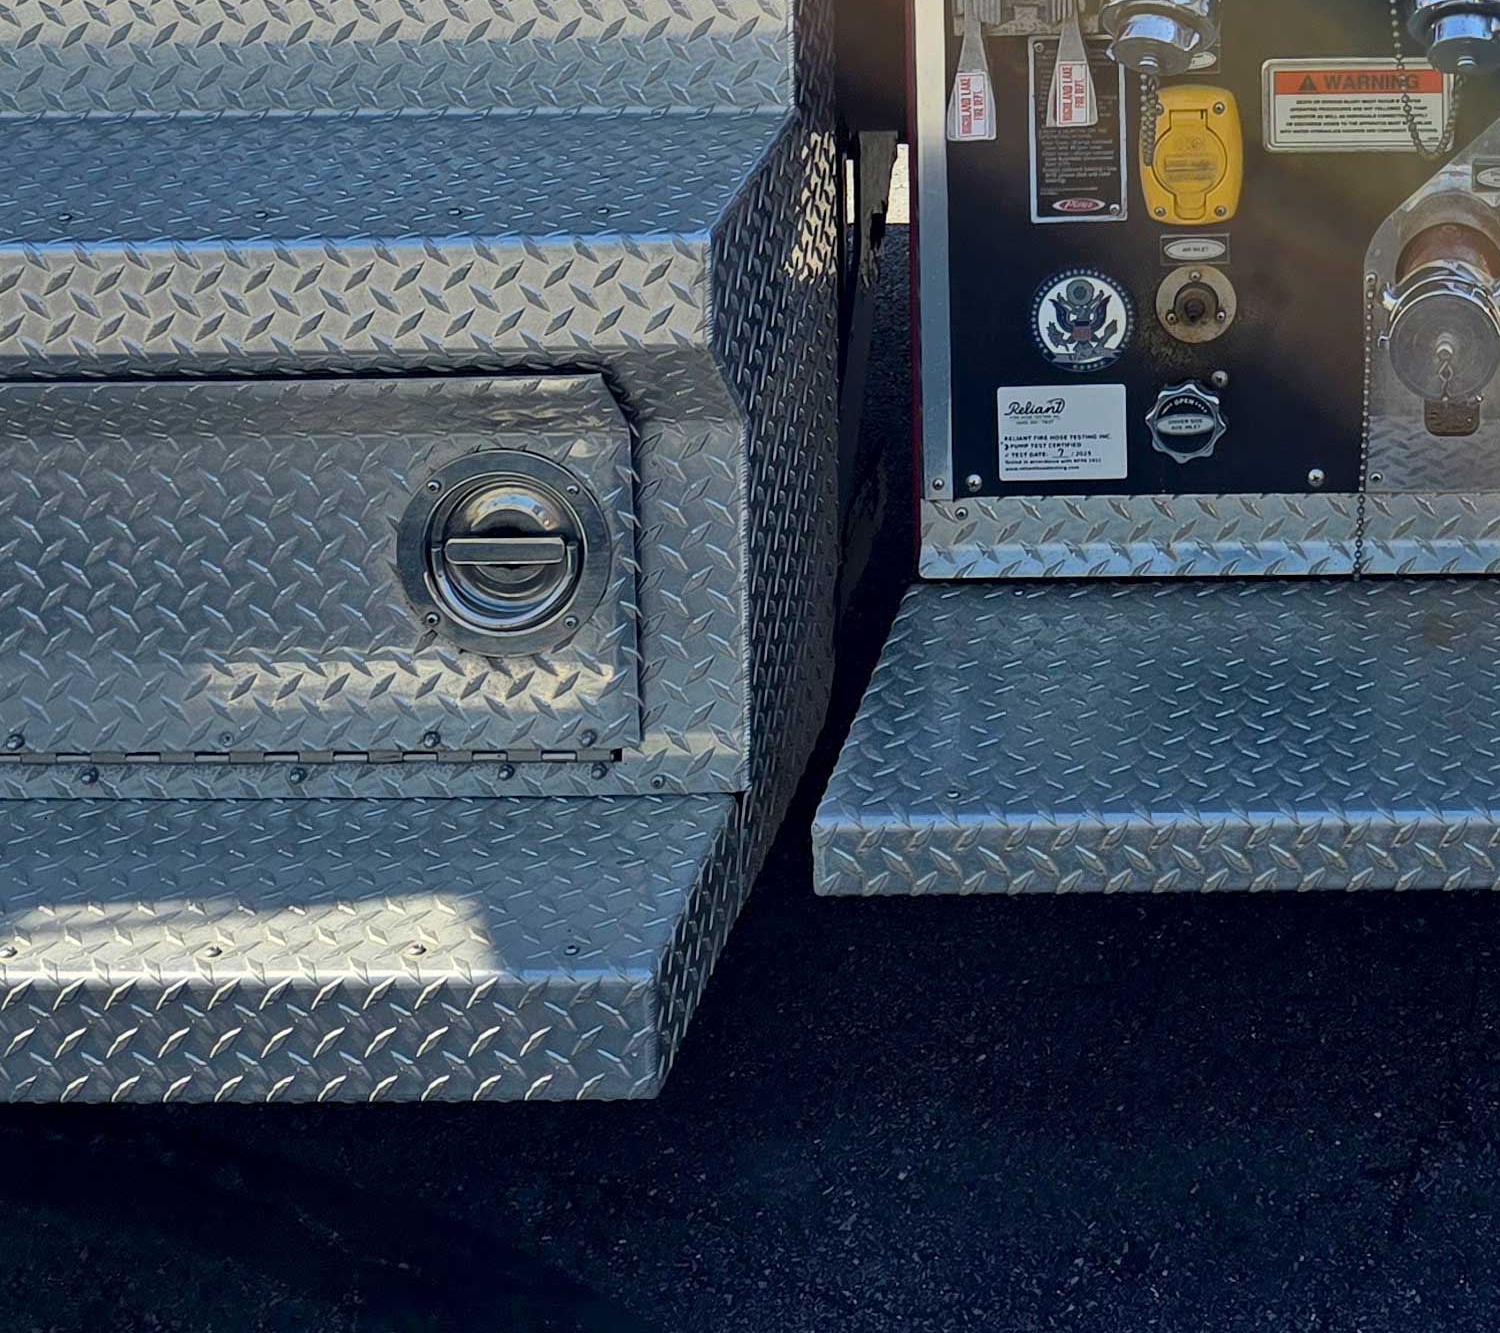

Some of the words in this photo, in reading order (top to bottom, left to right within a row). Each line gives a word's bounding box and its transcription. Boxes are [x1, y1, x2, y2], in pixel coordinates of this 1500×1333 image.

[1062, 67, 1073, 84] LAKE
[1325, 74, 1420, 91] WARNING
[960, 78, 971, 96] LAKE
[1004, 398, 1066, 416] Reliant
[1174, 398, 1195, 406] OPEN
